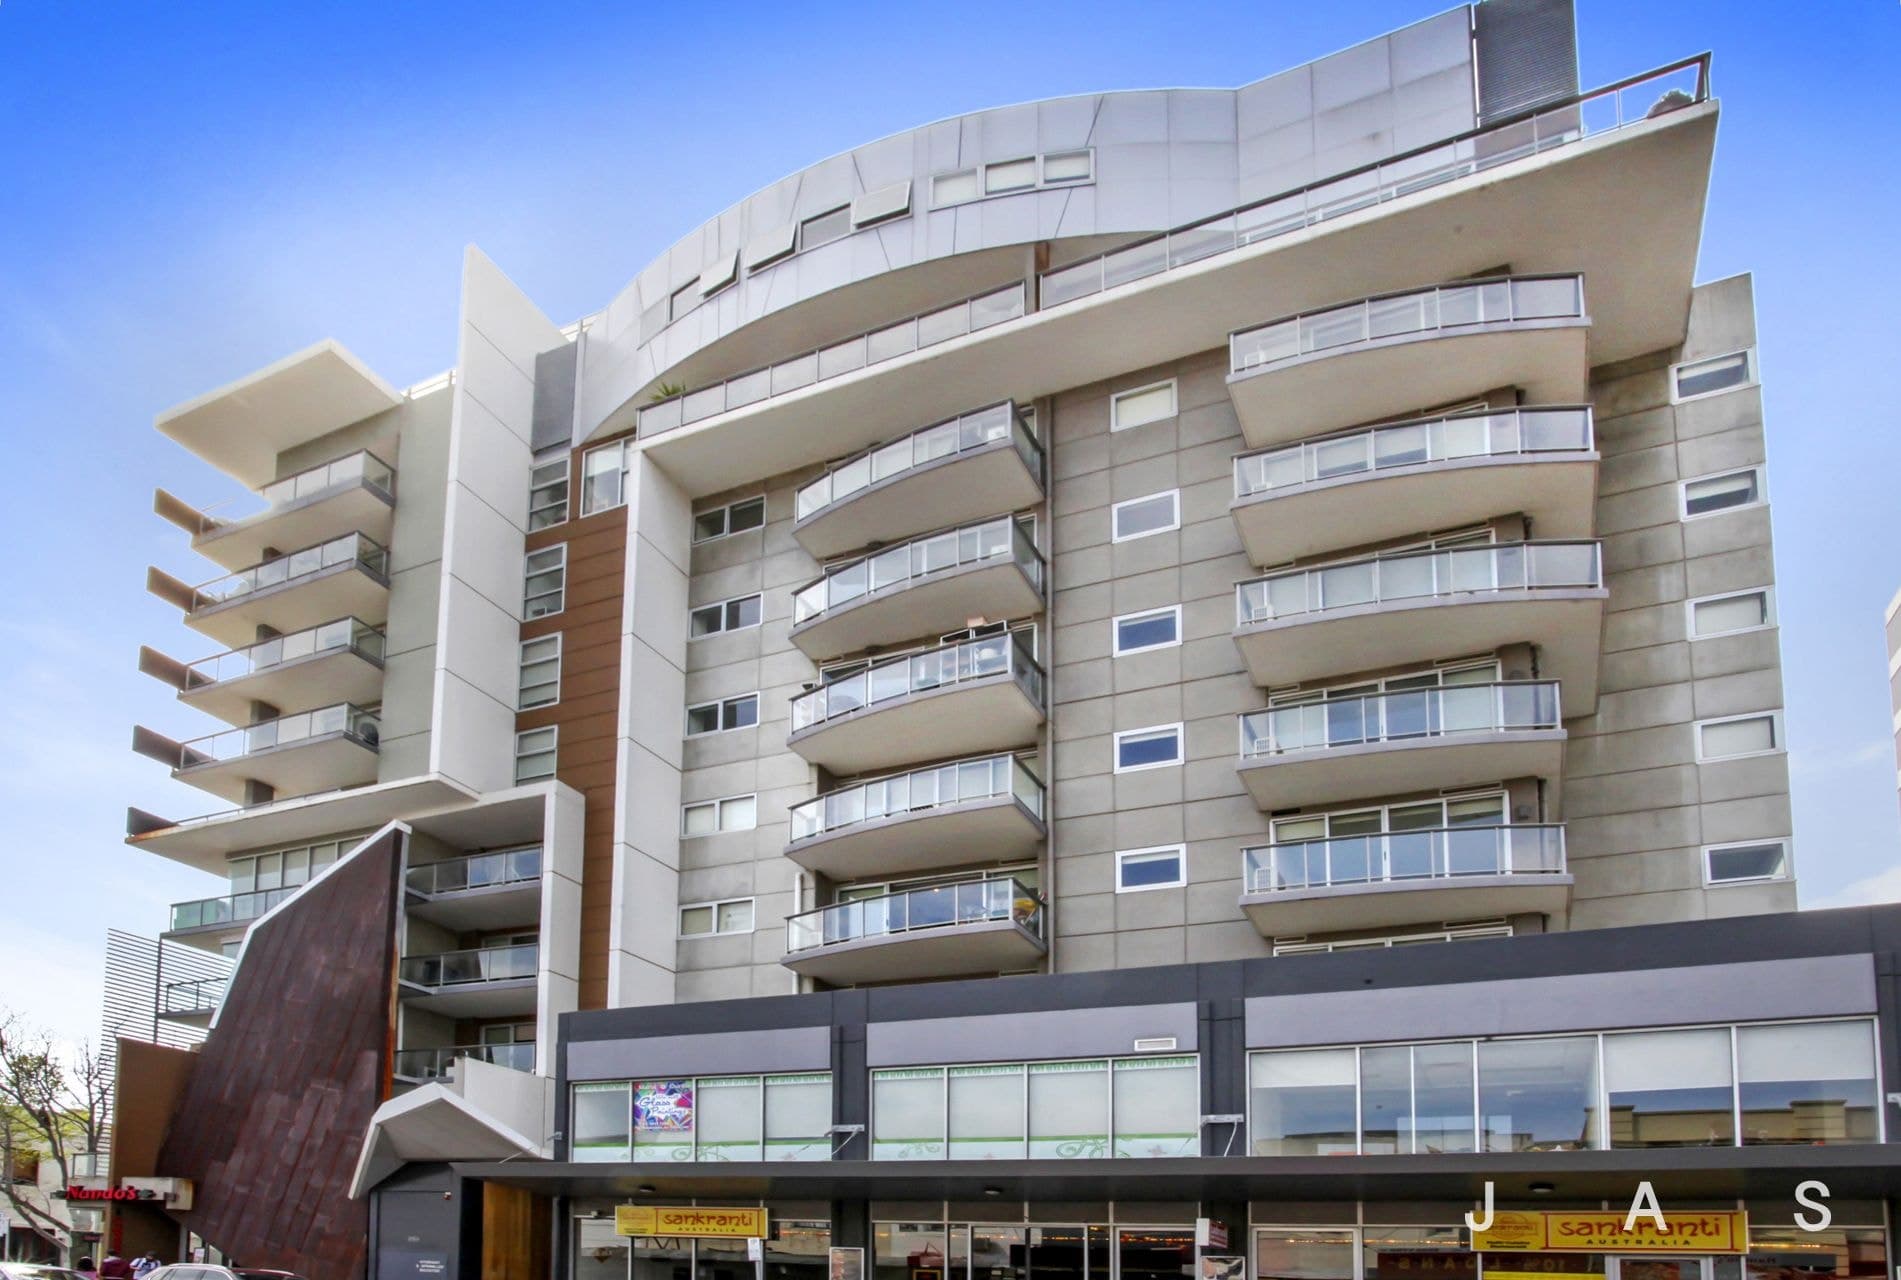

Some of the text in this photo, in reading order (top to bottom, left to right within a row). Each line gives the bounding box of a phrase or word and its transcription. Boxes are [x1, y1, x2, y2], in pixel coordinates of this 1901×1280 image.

[640, 1095, 671, 1107] Glass
[65, 1185, 136, 1200] Nando's
[663, 1212, 752, 1226] sankranti
[1558, 1216, 1721, 1237] sankranti
